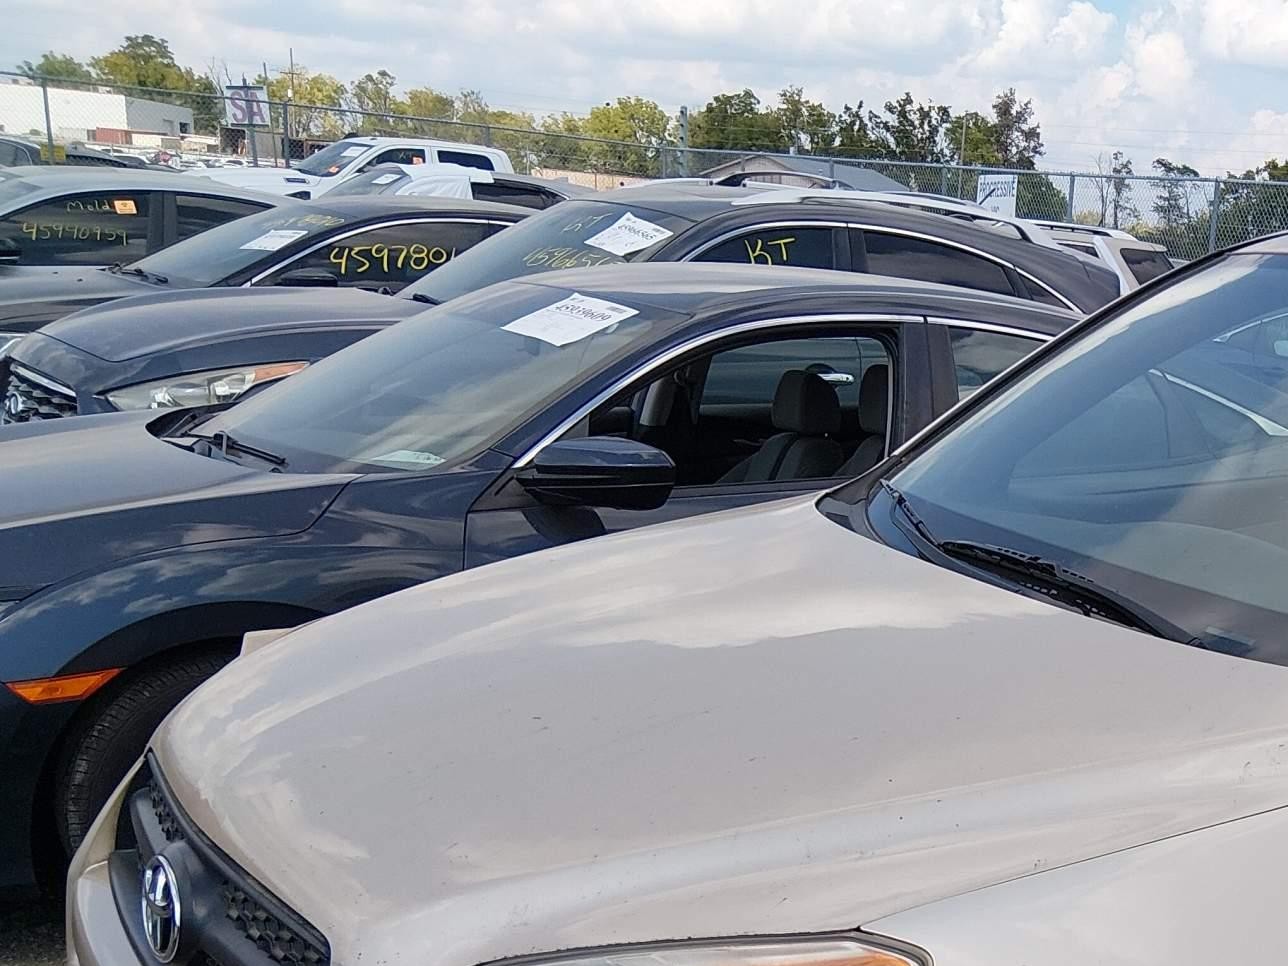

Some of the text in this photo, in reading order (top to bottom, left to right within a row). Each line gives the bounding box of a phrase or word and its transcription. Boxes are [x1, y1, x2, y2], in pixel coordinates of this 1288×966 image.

[230, 91, 266, 123] SA
[66, 200, 111, 212] Mold
[744, 238, 796, 266] KT
